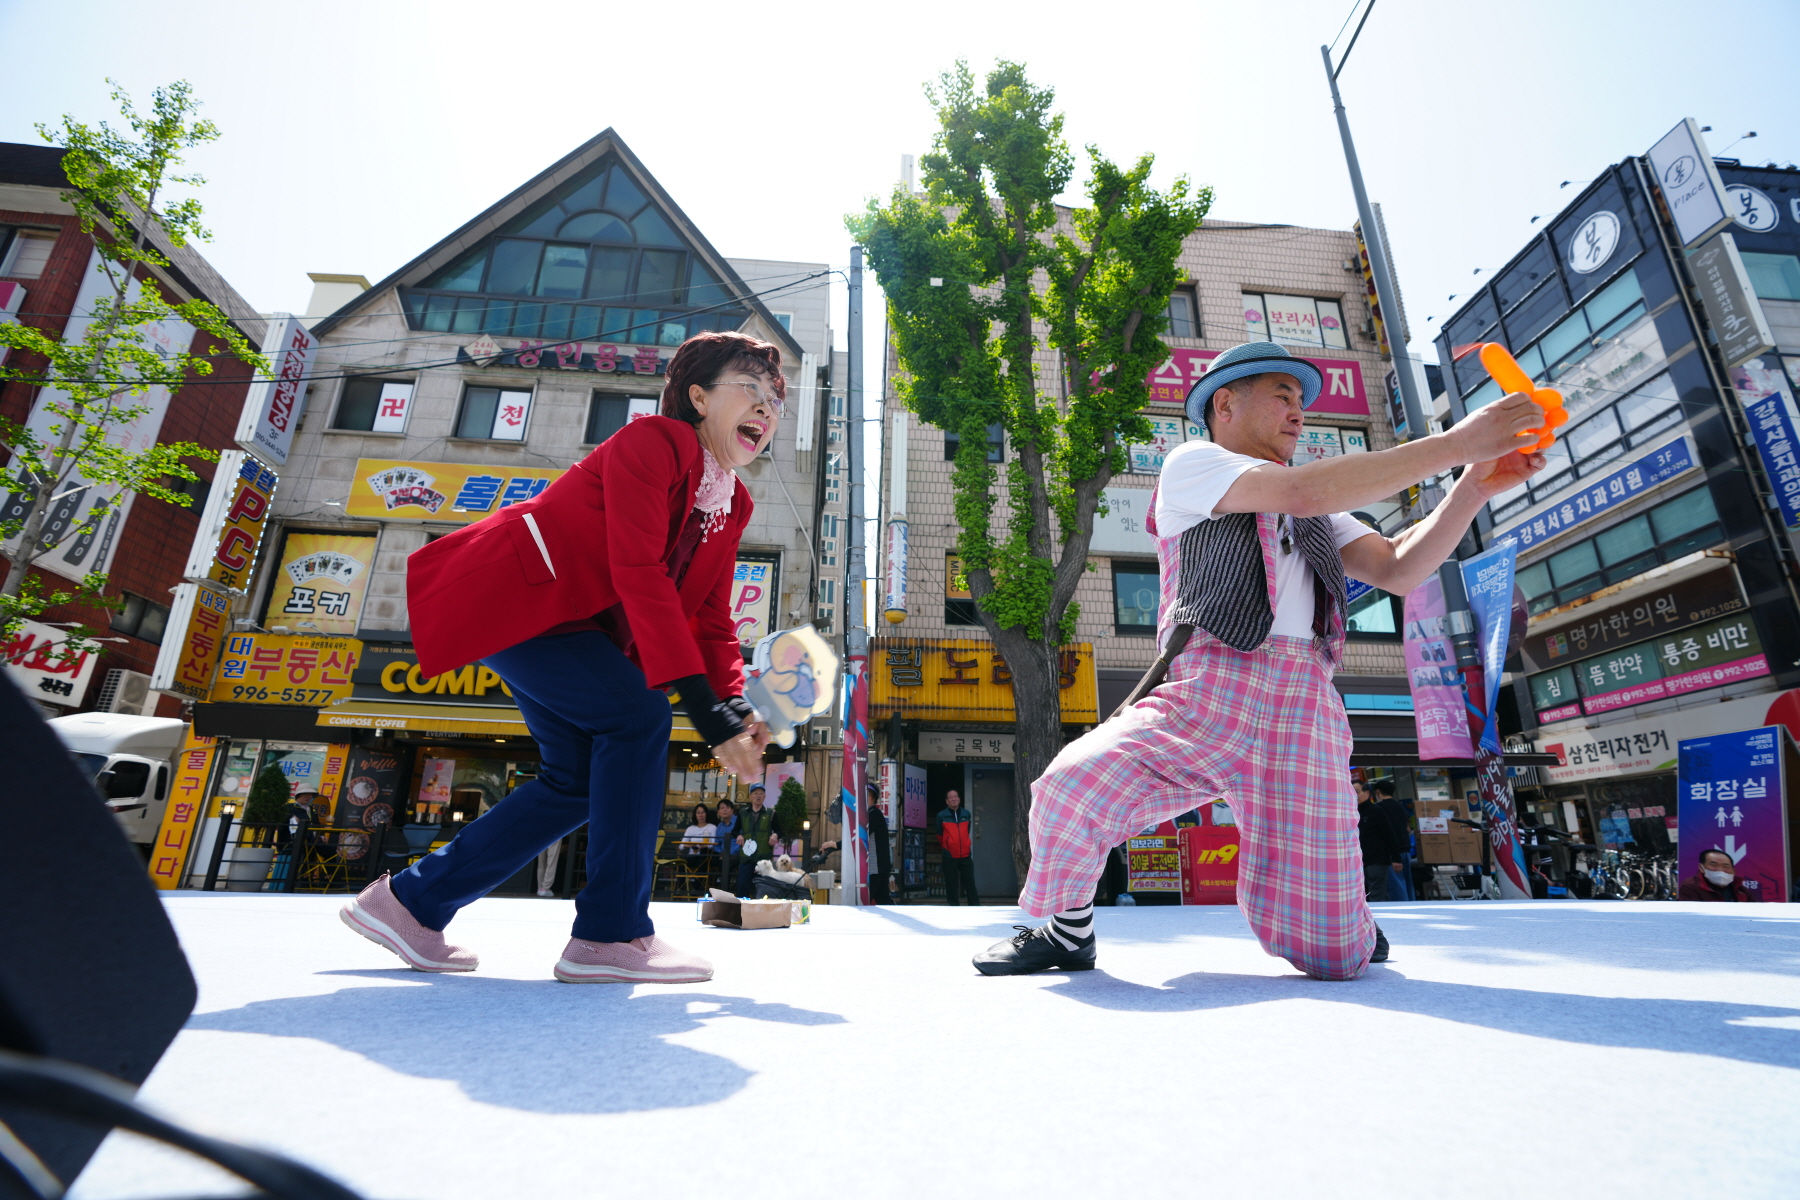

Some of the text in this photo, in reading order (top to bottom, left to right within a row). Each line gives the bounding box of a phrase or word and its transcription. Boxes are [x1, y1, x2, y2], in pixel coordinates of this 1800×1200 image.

[1674, 181, 1705, 209] Place
[1270, 311, 1316, 327] 보리사
[474, 341, 494, 349] 24시
[517, 340, 662, 375] 성인용품
[501, 405, 524, 427] 천
[269, 428, 279, 440] 3F
[1656, 450, 1673, 468] 3F
[240, 459, 276, 493] 홈런
[1520, 468, 1645, 544] 강북서울치과의원
[216, 485, 267, 571] PC
[1121, 517, 1139, 532] 있는
[219, 570, 236, 587] 2F
[733, 564, 767, 581] 홈런
[950, 560, 960, 593] MUSIC
[200, 590, 227, 614] 대원
[284, 586, 350, 615] 포커
[1570, 595, 1679, 650] 명가한의원
[183, 608, 220, 685] 부동산
[223, 637, 253, 679] 대원
[249, 647, 356, 685] 부동산
[1547, 623, 1749, 698] 침 뜸 한약 통증 비만
[1665, 660, 1766, 692] 명가한의원 992-1025
[174, 681, 208, 698] 996-5577
[232, 685, 333, 704] 996-5577
[1584, 685, 1664, 710] 명가한의원 992-1025
[329, 717, 407, 728] COMPOSE COFFEE
[1550, 705, 1577, 720] 992-1025
[955, 738, 1002, 754] 골목방
[1568, 730, 1670, 765] 삼천리자전거
[360, 758, 397, 771] Waffle
[906, 776, 926, 803] 마사지
[1690, 777, 1767, 802] 화장실
[1130, 839, 1164, 849] 점보라면
[1197, 844, 1239, 864] 119
[1131, 854, 1150, 871] 30분
